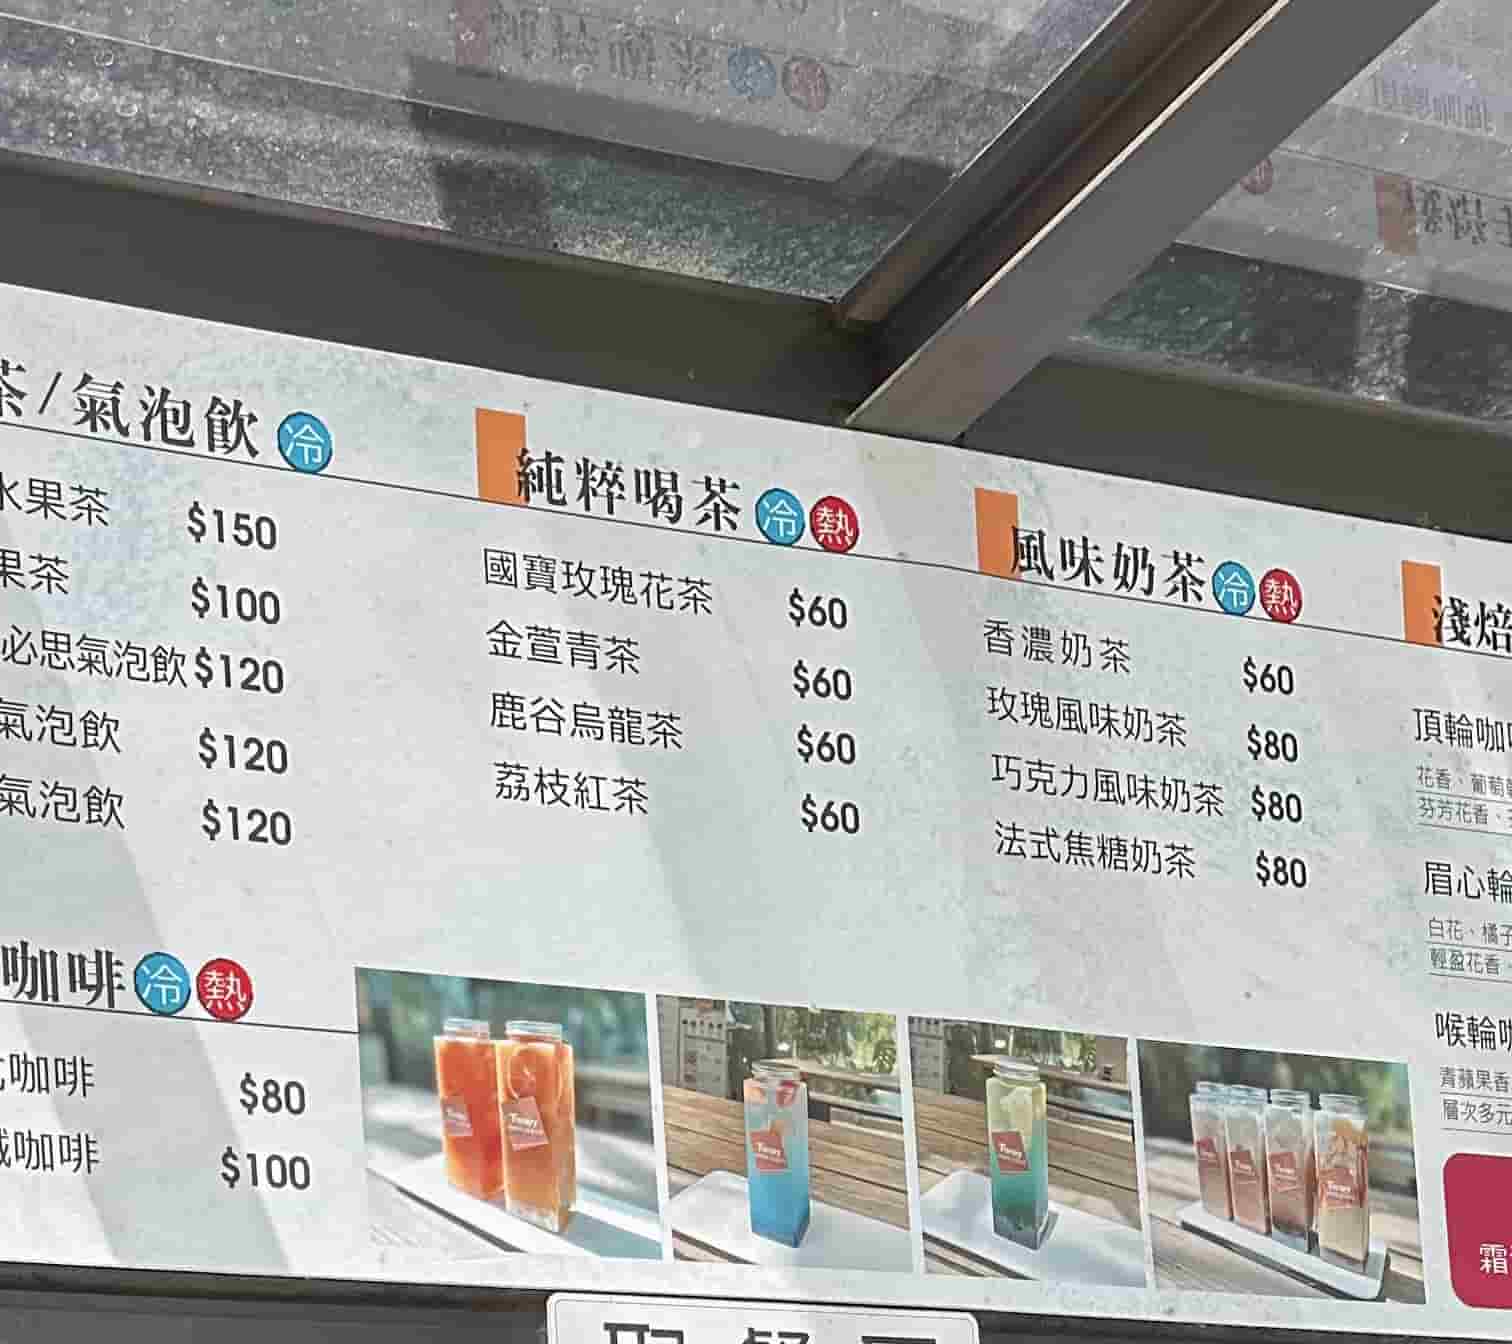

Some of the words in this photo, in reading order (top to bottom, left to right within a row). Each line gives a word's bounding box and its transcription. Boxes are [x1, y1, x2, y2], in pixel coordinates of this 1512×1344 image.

[282, 420, 328, 467] 冷
[187, 501, 277, 551] $150
[515, 448, 742, 533] 純粹喝茶
[761, 498, 801, 542] 冷
[814, 503, 855, 547] 熱
[191, 576, 281, 626] $100
[483, 548, 713, 616] 國寶玫瑰花茶
[788, 587, 848, 631] $60
[1009, 525, 1207, 604] 風味奶茶
[1216, 566, 1251, 610] 冷
[1262, 573, 1299, 618] 熱
[193, 647, 284, 695] $120
[486, 619, 640, 675] 金萱青茶
[792, 659, 853, 701] $60
[983, 619, 1131, 673] 香濃奶茶
[1243, 656, 1294, 696] $60
[198, 727, 288, 775] $120
[490, 691, 683, 750] 鹿谷烏龍茶
[796, 724, 857, 766] $60
[986, 686, 1187, 747] 玫瑰風味奶茶
[1247, 724, 1299, 764] $80
[1412, 707, 1512, 752] 頂輪咖
[494, 761, 648, 815] 荔枝紅茶
[800, 794, 860, 835] $60
[991, 753, 1225, 817] 巧克力風味奶茶
[1251, 785, 1303, 824] $80
[201, 799, 291, 846] $120
[994, 820, 1197, 881] 法式焦糖奶茶
[1255, 850, 1308, 889] $80
[138, 964, 186, 1010] 冷
[201, 969, 249, 1014] 熱
[239, 1072, 306, 1115] $80
[220, 1146, 311, 1191] $100
